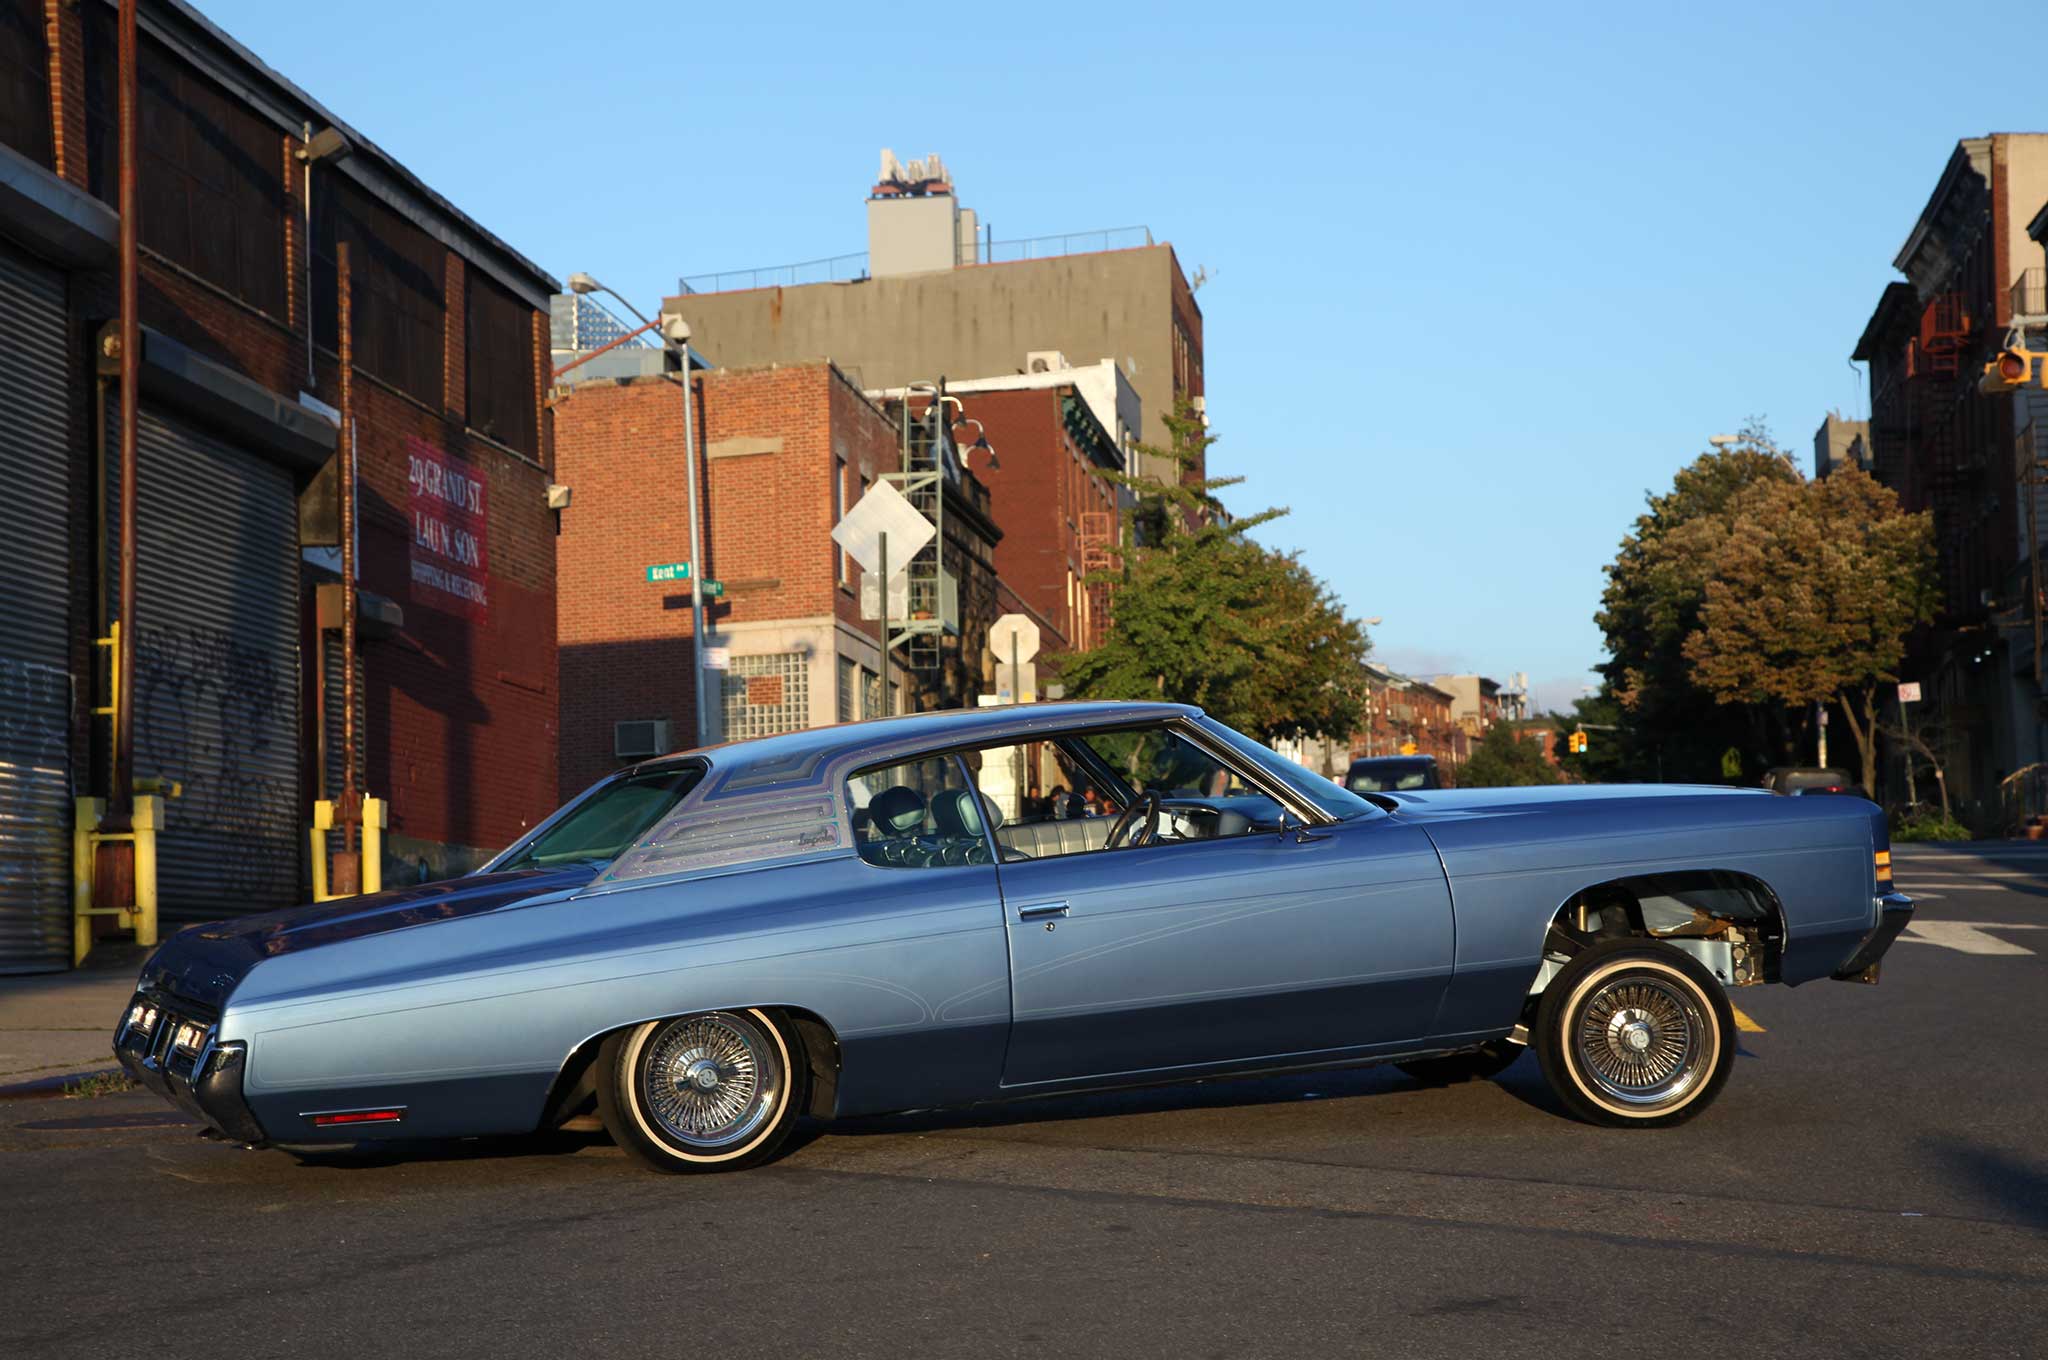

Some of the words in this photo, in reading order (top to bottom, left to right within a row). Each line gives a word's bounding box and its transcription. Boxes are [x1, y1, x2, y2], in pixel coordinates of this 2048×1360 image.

[425, 458, 466, 507] GRAND
[454, 528, 479, 568] SON
[652, 566, 674, 580] Kent
